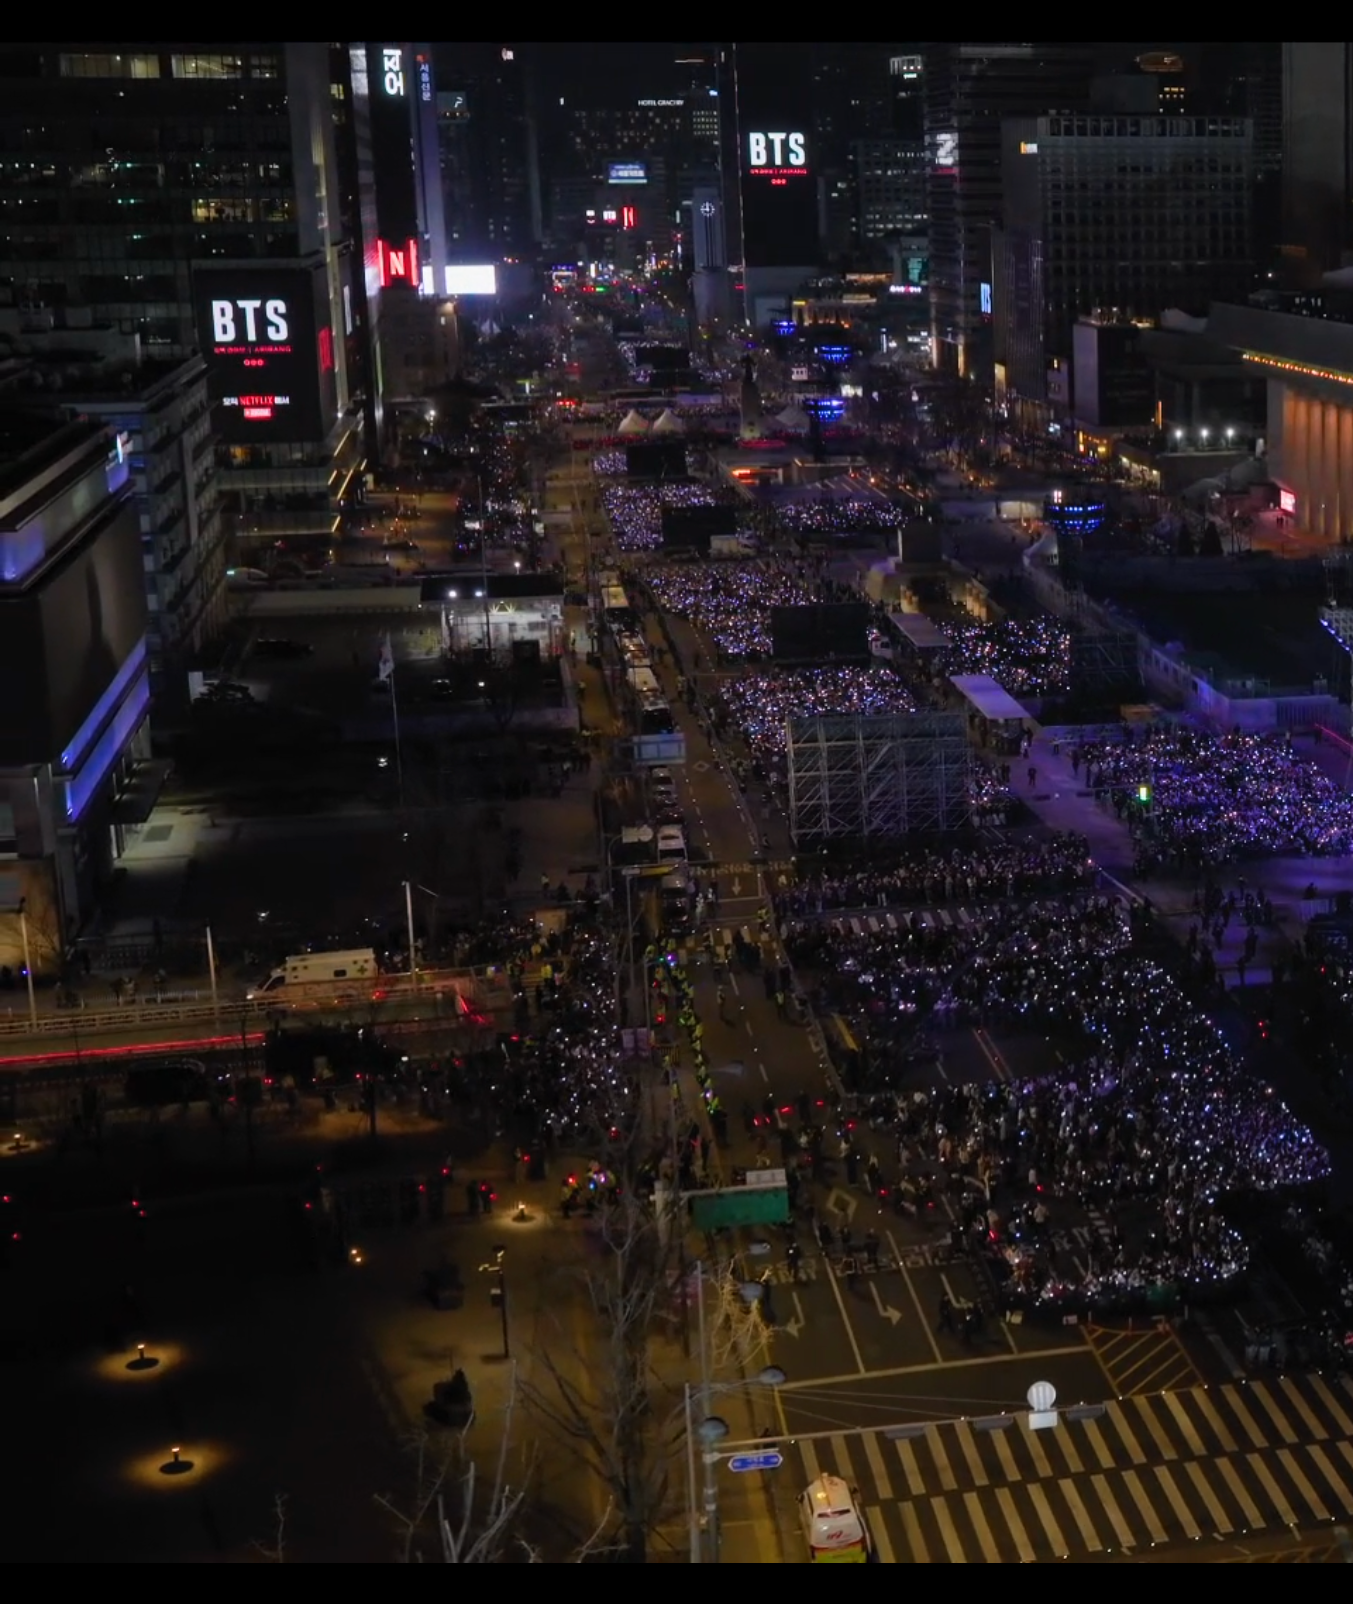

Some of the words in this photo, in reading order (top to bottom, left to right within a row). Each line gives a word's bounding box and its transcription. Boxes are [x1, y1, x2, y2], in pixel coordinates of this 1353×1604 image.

[749, 132, 806, 166] BTS
[390, 252, 405, 275] N
[212, 300, 289, 342] BTS
[239, 396, 274, 406] NETFLIX
